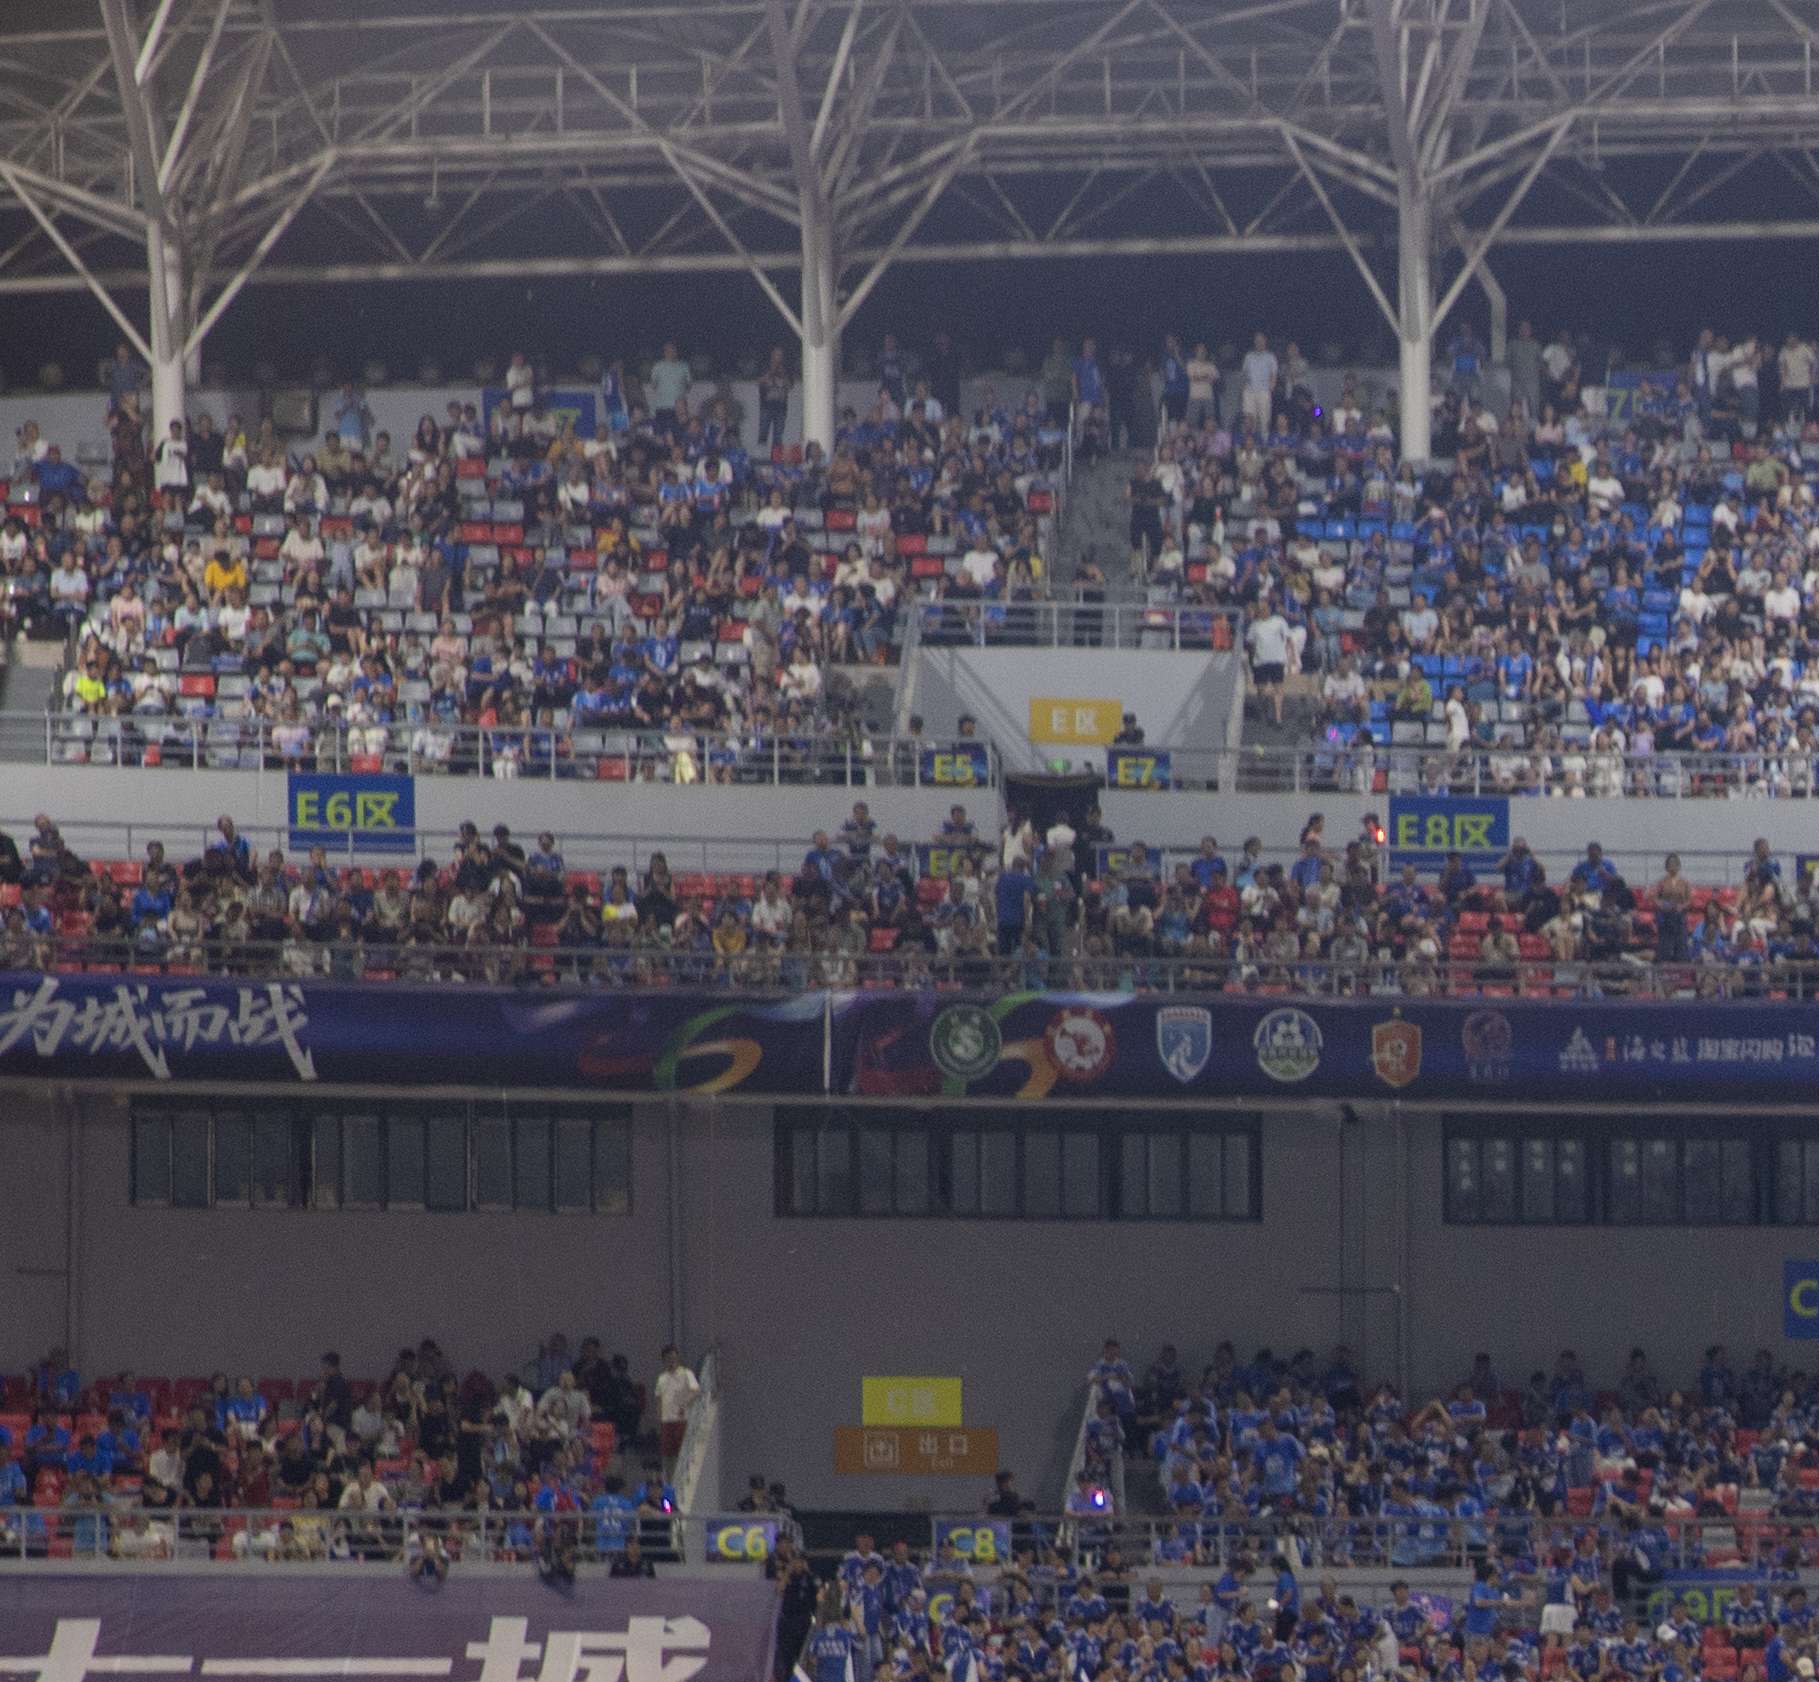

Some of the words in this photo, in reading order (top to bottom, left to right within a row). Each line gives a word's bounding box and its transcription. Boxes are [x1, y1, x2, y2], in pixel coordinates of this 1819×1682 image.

[934, 753, 974, 783] E5
[1118, 757, 1156, 786] E7
[297, 791, 398, 831] E6区
[1397, 813, 1495, 848] E8区
[0, 976, 318, 1080] 为城而战
[716, 1525, 767, 1560] C6
[949, 1526, 996, 1560] C8
